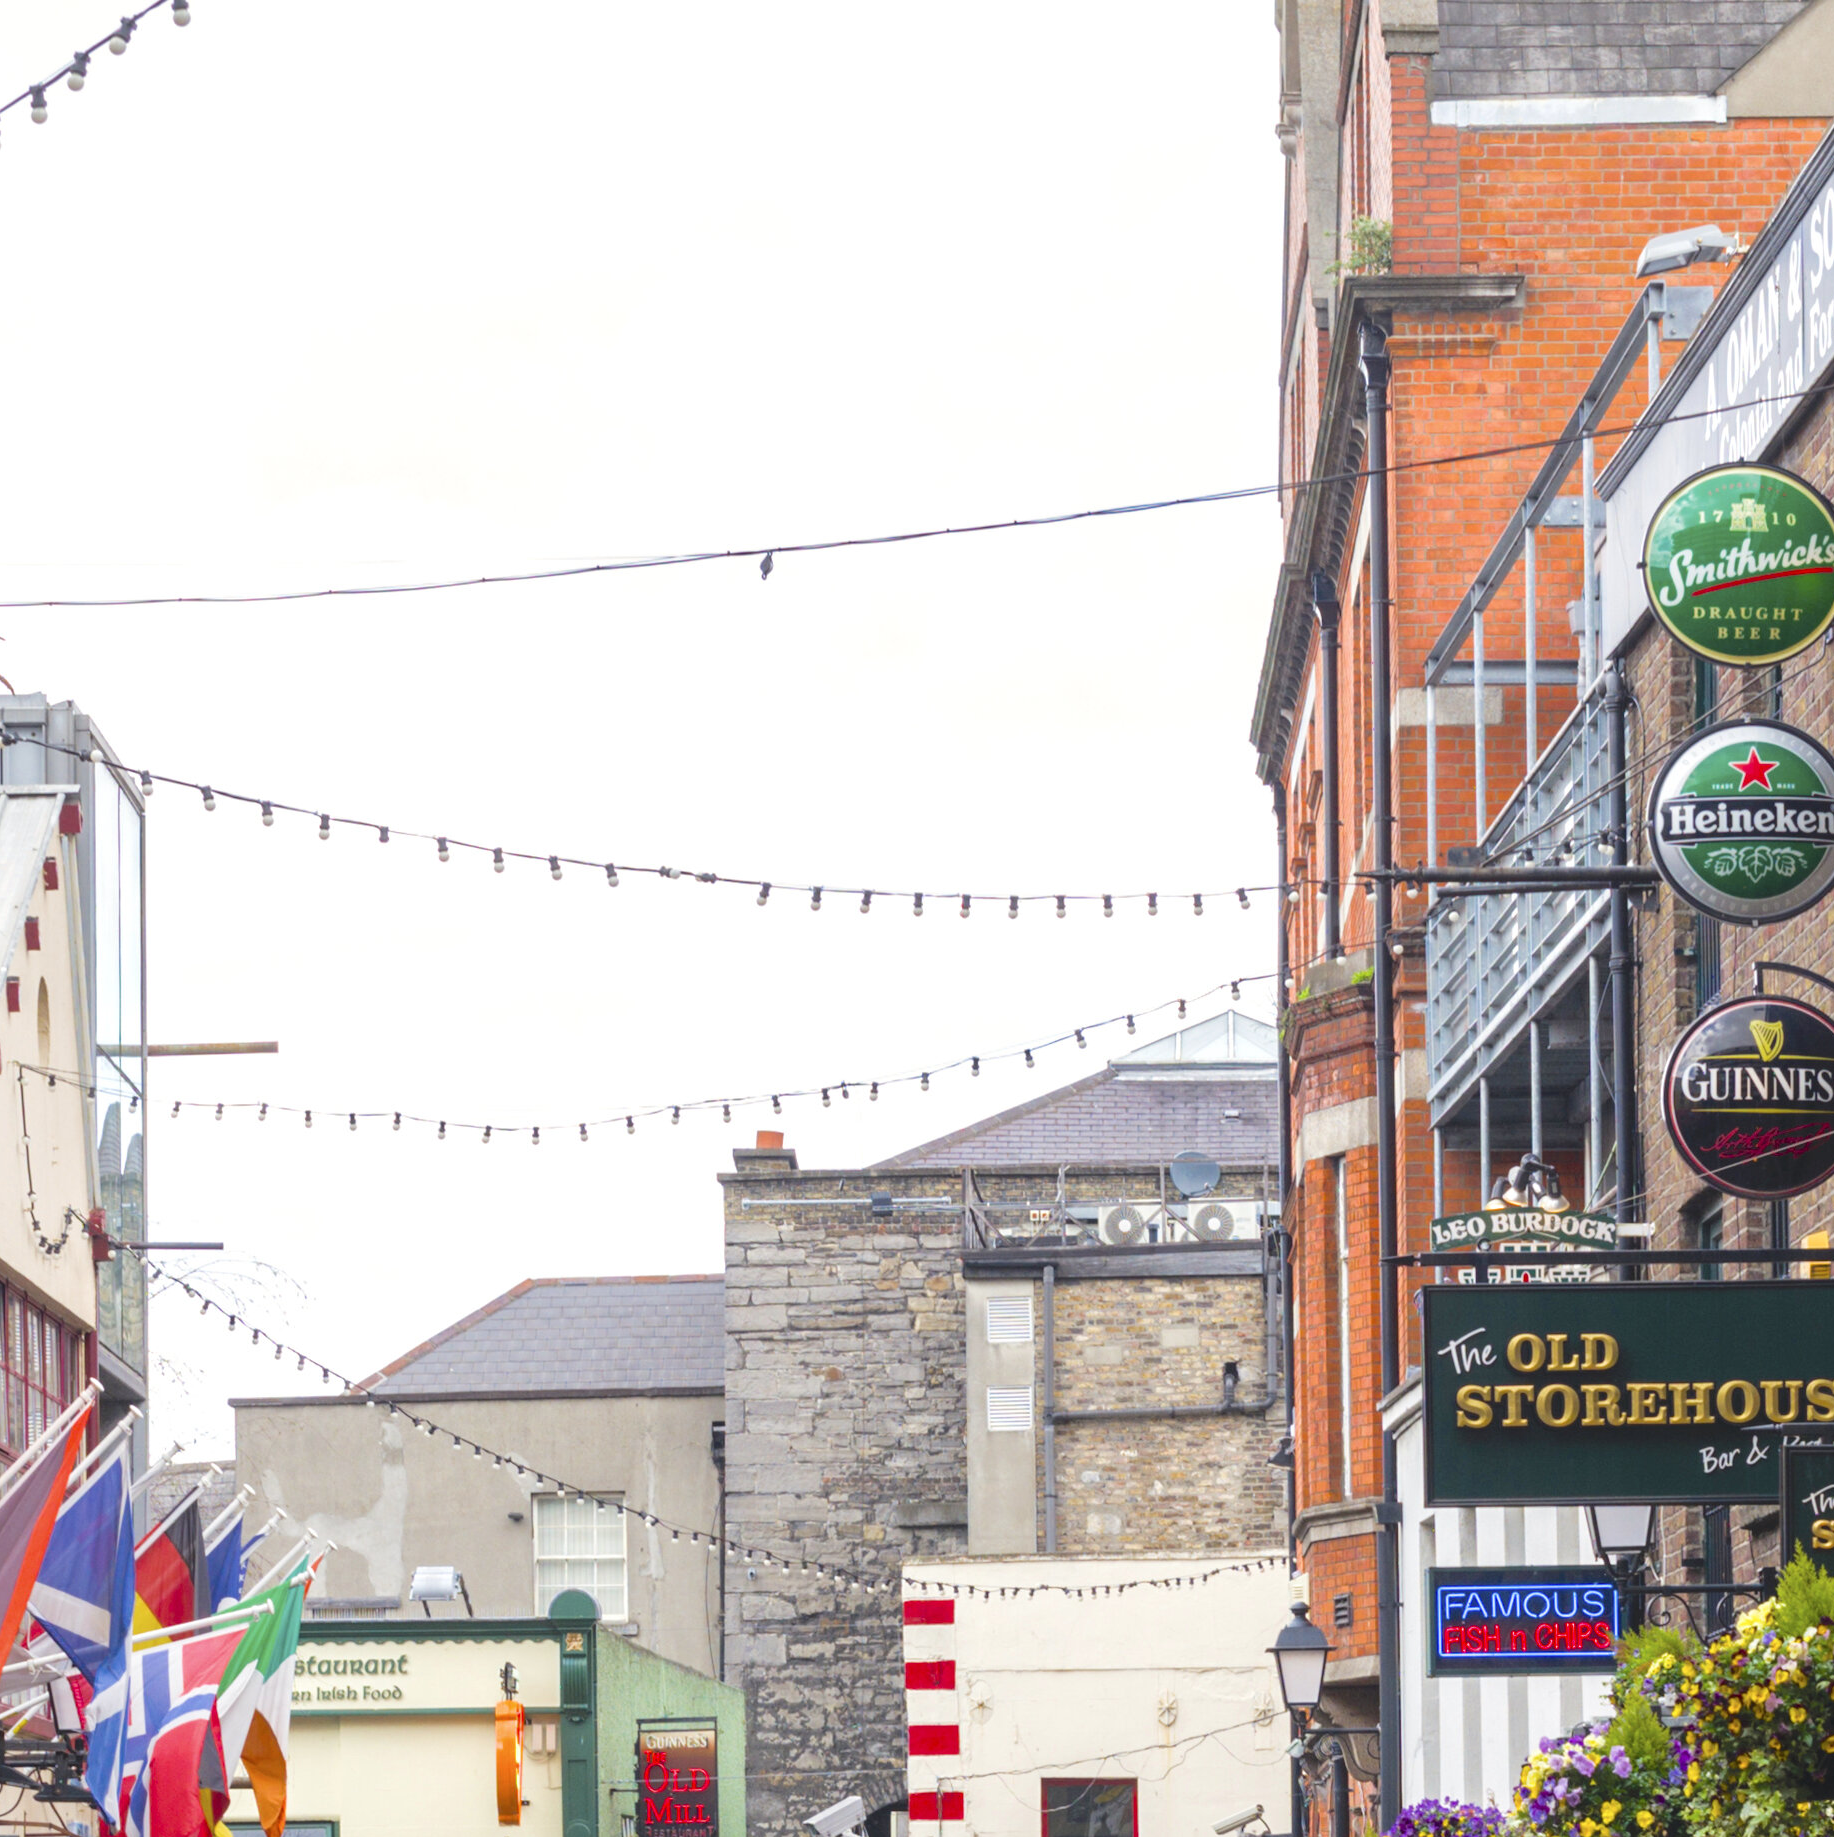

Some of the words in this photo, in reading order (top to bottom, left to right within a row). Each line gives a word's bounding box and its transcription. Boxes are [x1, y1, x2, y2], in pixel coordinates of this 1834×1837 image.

[1726, 264, 1781, 402] OMAN
[1777, 323, 1803, 415] and
[1693, 606, 1803, 621] DRAUGHT
[1718, 627, 1781, 640] BEER
[1433, 1216, 1486, 1244] LEO
[1490, 1212, 1616, 1242] BURDOCK
[1438, 1327, 1497, 1375] The
[1506, 1332, 1620, 1374] OLD
[1699, 1446, 1740, 1473] Bar
[1746, 1435, 1770, 1465] &
[1443, 1589, 1605, 1620] FAMOUS
[1443, 1624, 1502, 1654] FISH
[1535, 1621, 1612, 1651] CHIPS
[316, 1684, 358, 1702] Irish
[363, 1684, 403, 1701] Food
[644, 1750, 667, 1763] THE
[645, 1734, 708, 1749] GUINNESS
[644, 1763, 711, 1793] OLD
[644, 1797, 711, 1824] MILL
